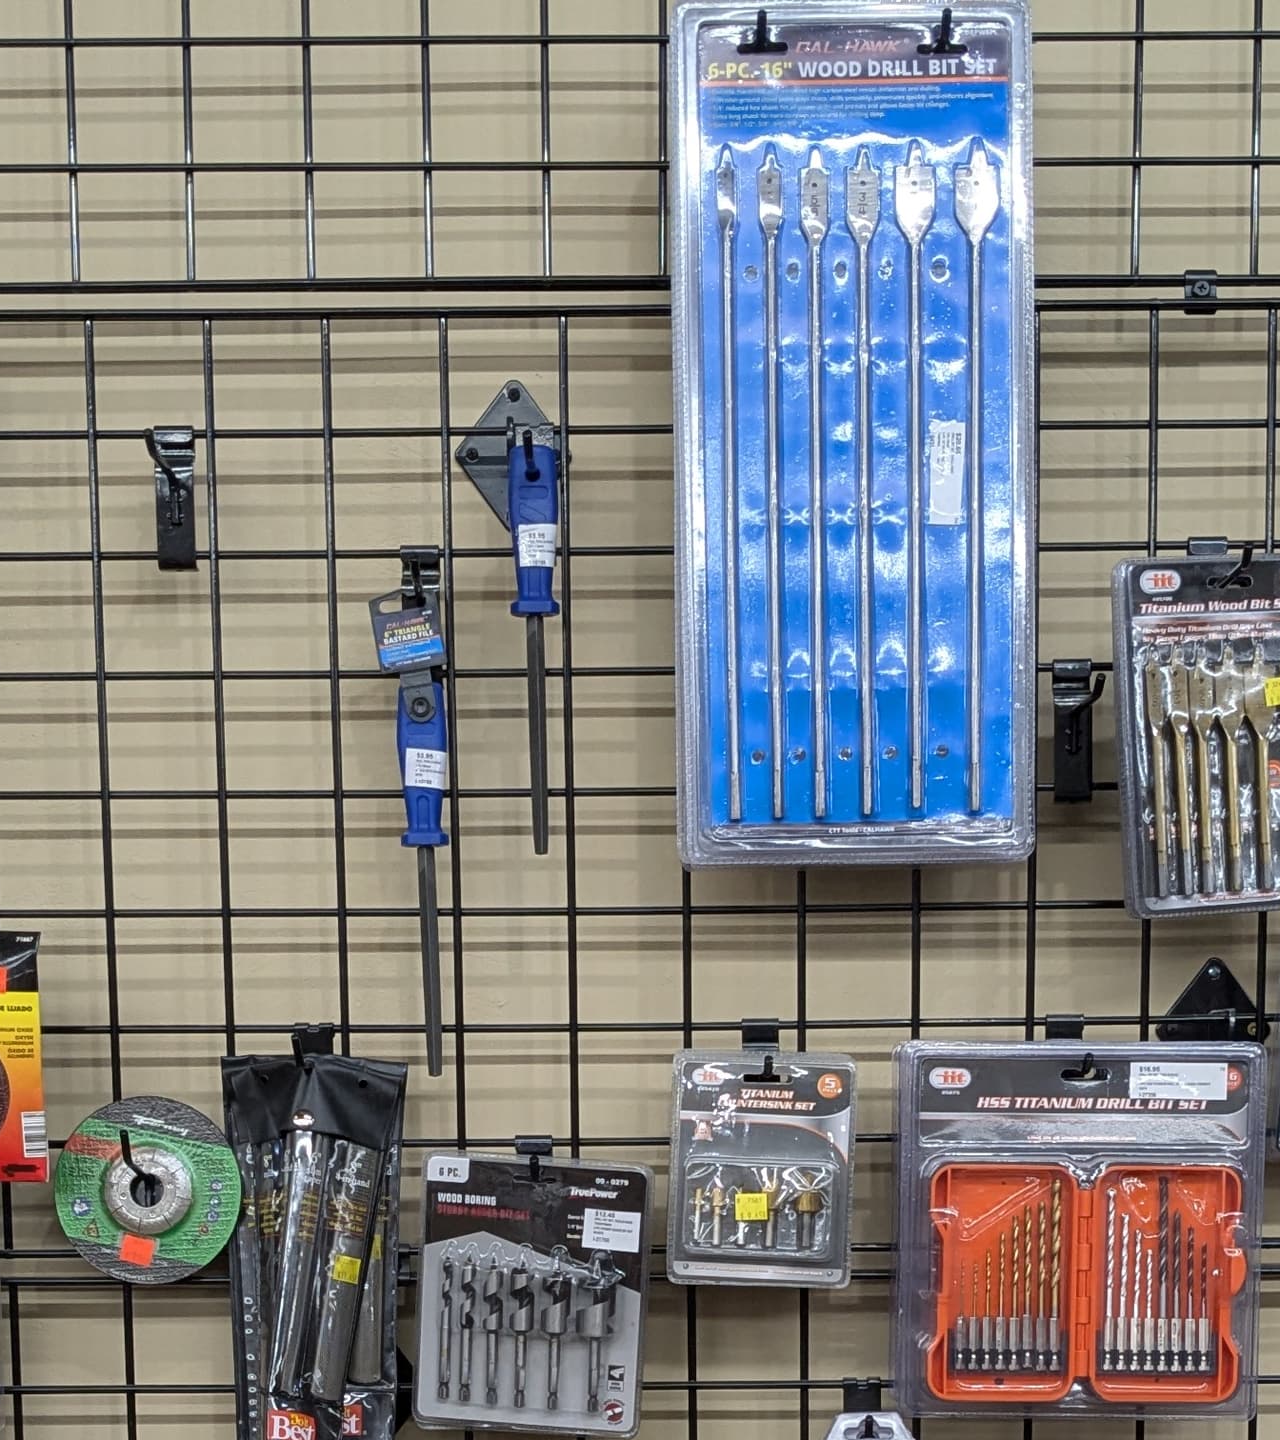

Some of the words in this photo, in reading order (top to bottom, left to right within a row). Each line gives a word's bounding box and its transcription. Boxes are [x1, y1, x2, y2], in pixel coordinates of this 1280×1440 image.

[798, 61, 861, 78] WOOD
[867, 60, 923, 77] DRILL
[929, 59, 959, 76] BIT
[963, 58, 997, 75] SET
[1140, 602, 1205, 614] Titanium
[1208, 600, 1247, 611] Wood
[1250, 599, 1270, 610] Bit
[394, 623, 431, 635] TRIANGLE
[384, 633, 418, 645] BASTARD
[419, 630, 433, 638] FILE
[824, 1077, 836, 1087] 5
[740, 1089, 795, 1099] TITANIUM
[794, 1102, 816, 1111] SET
[976, 1096, 1009, 1109] HSS
[1013, 1097, 1093, 1109] TITANIUM
[1096, 1097, 1144, 1109] DRILL
[1148, 1098, 1176, 1110] BIT
[1178, 1099, 1208, 1110] SET
[132, 1115, 189, 1135] Forney
[439, 1167, 445, 1176] 6
[447, 1168, 462, 1177] PC.
[570, 1186, 618, 1198] TruePower
[437, 1192, 462, 1203] WOOD
[464, 1194, 497, 1206] BORING
